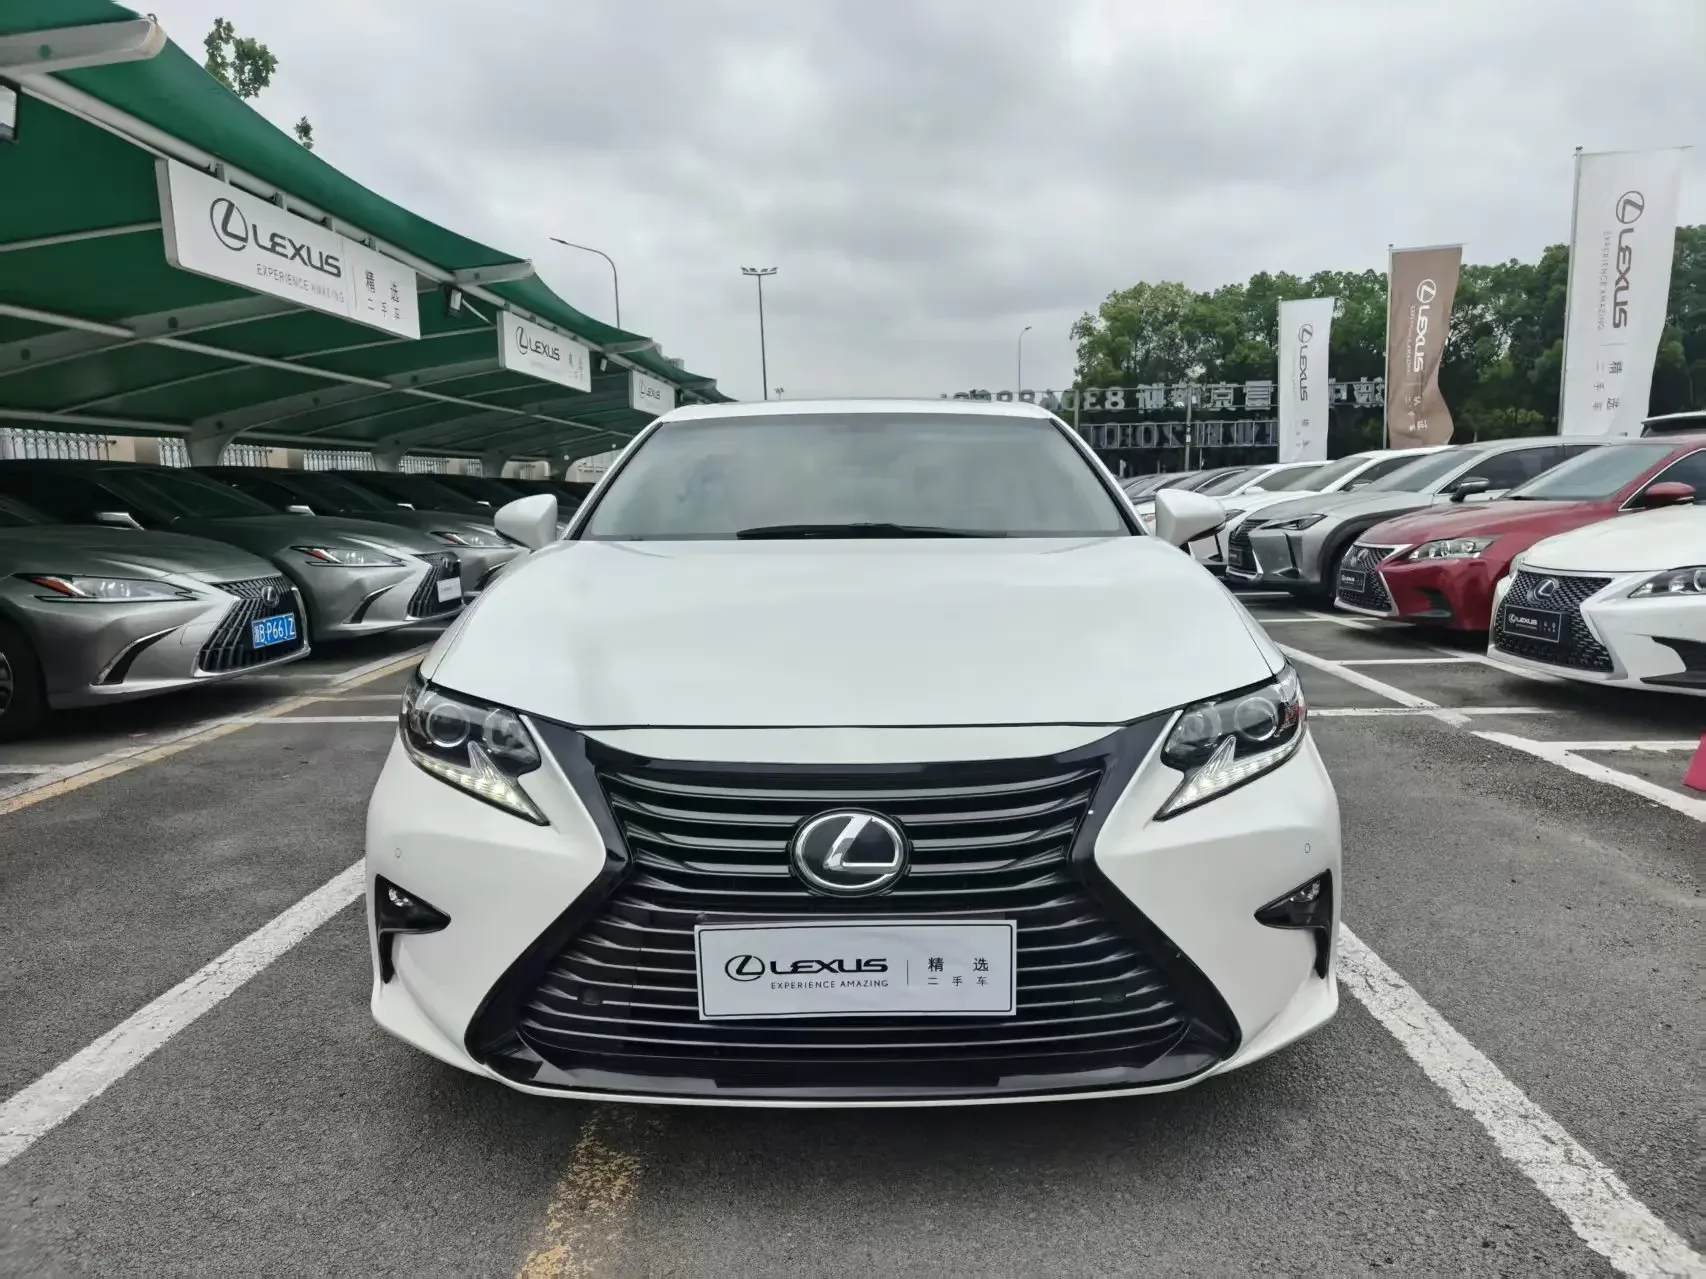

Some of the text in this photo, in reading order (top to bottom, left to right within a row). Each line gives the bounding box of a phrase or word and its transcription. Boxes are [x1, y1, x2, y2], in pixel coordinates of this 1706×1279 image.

[252, 223, 342, 278] LEXUS
[256, 263, 310, 292] EXPERIENCE
[1612, 227, 1635, 329] LEXUS
[529, 336, 561, 361] LEXUS
[1414, 305, 1431, 373] LEXUS
[1299, 345, 1308, 402] LEXUS
[646, 387, 661, 400] LEXUS
[769, 957, 889, 975] LEXUS
[927, 956, 990, 973] 精选
[770, 979, 889, 990] EXPERIENCE AMAZING
[927, 976, 989, 987] 二手车
